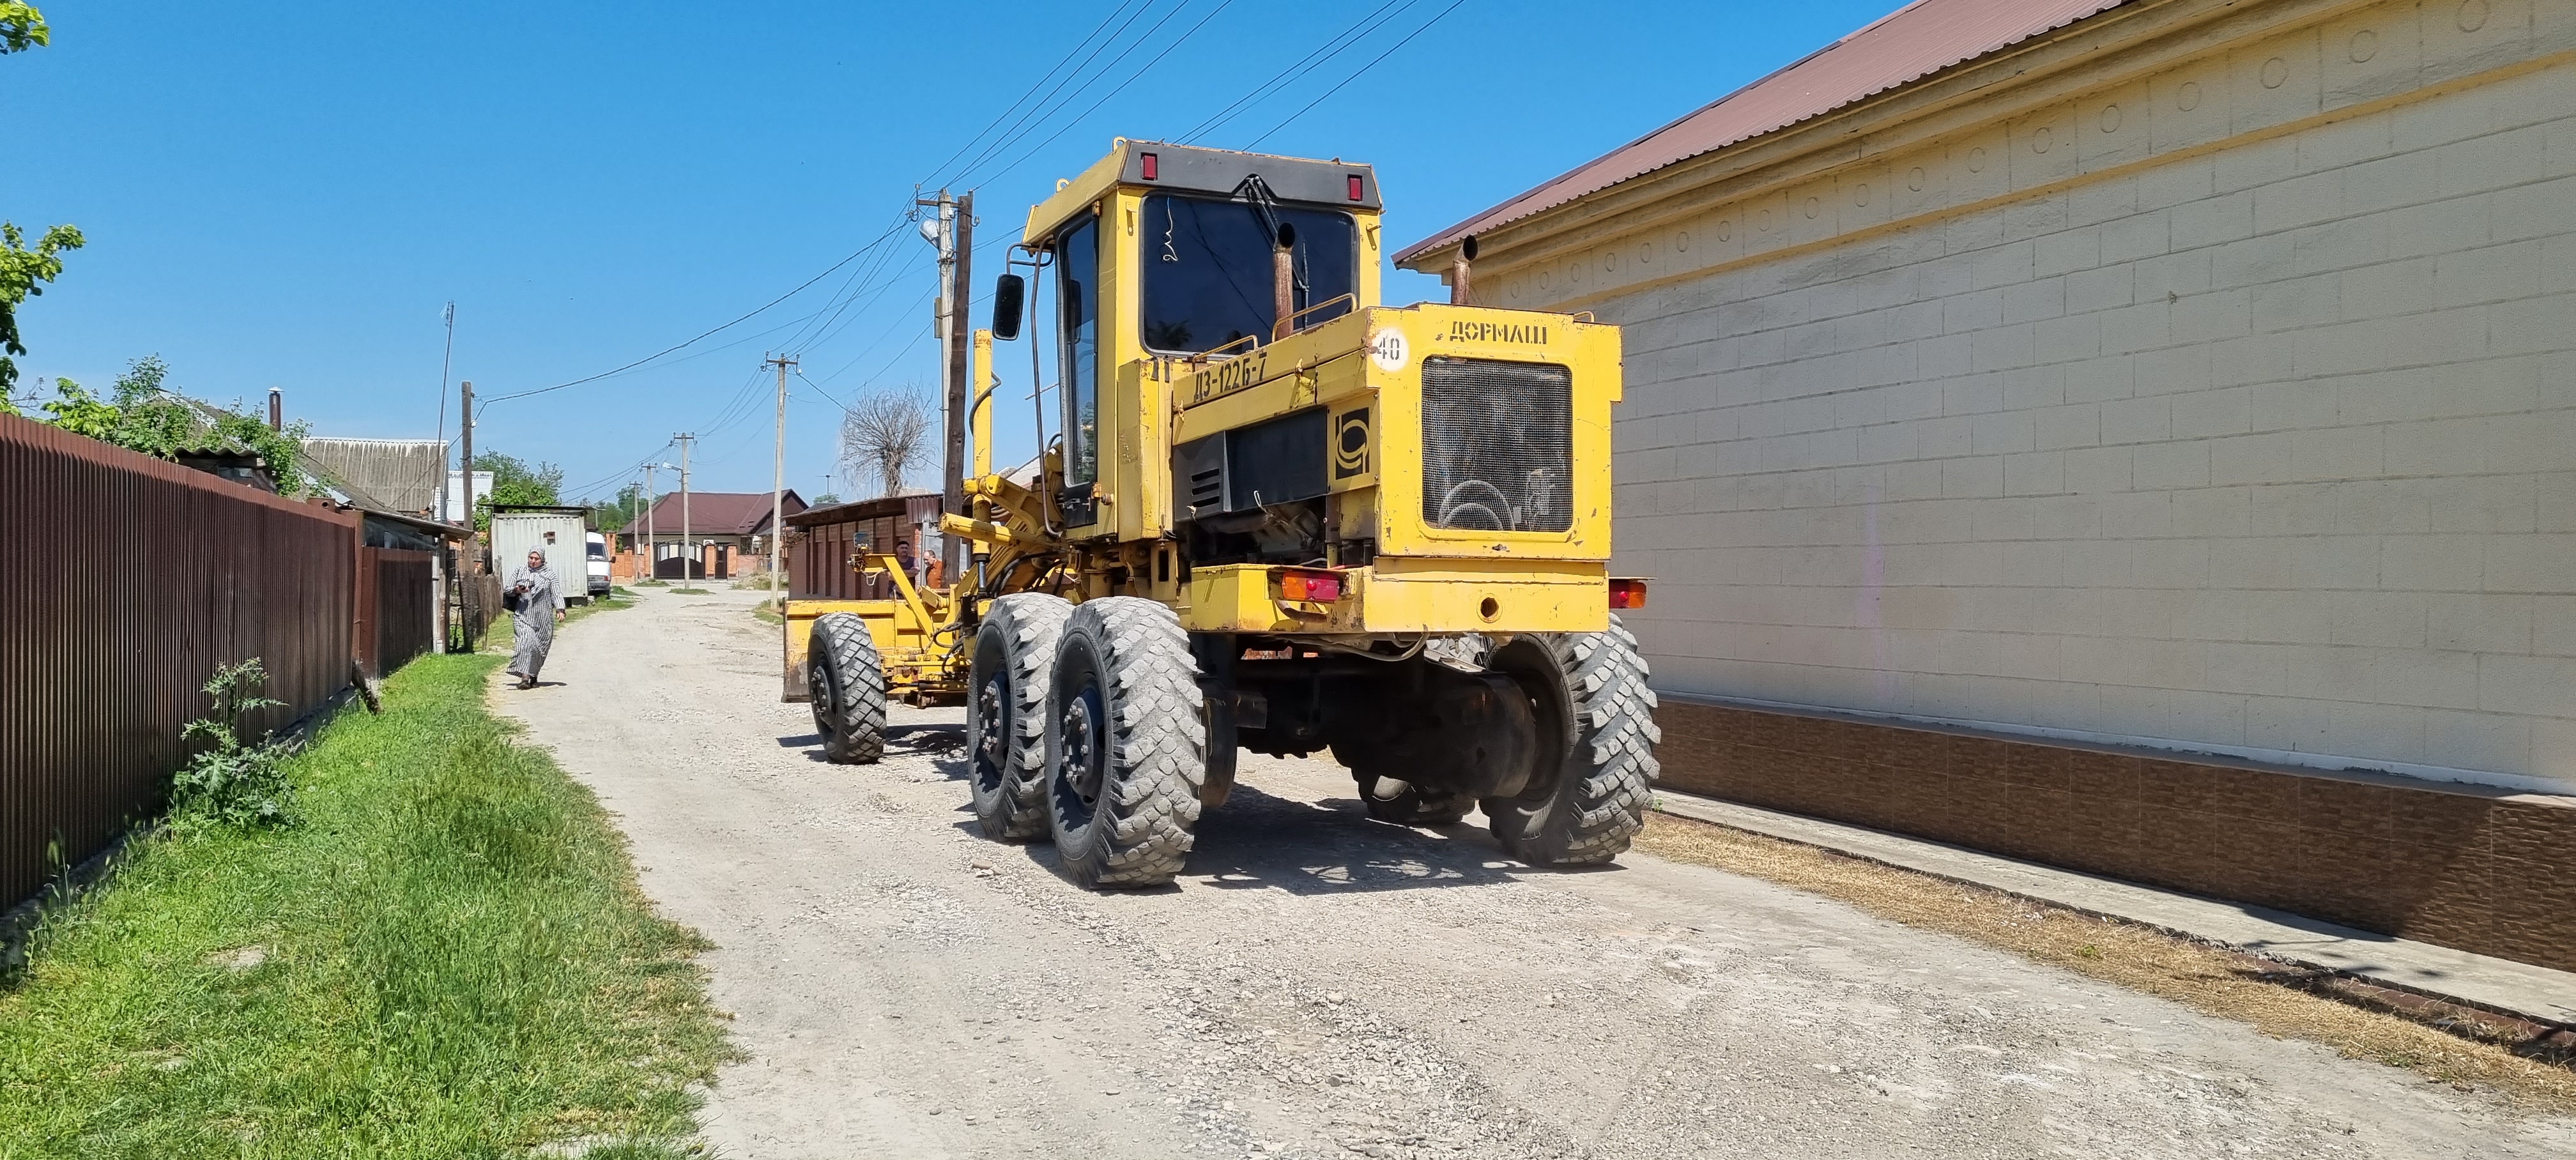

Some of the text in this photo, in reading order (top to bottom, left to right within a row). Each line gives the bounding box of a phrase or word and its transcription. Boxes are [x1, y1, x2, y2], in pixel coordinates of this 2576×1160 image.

[1450, 321, 1547, 344] ДОРМАШ
[1377, 337, 1400, 360] 40
[1193, 351, 1268, 403] ДЗ-122Б-7
